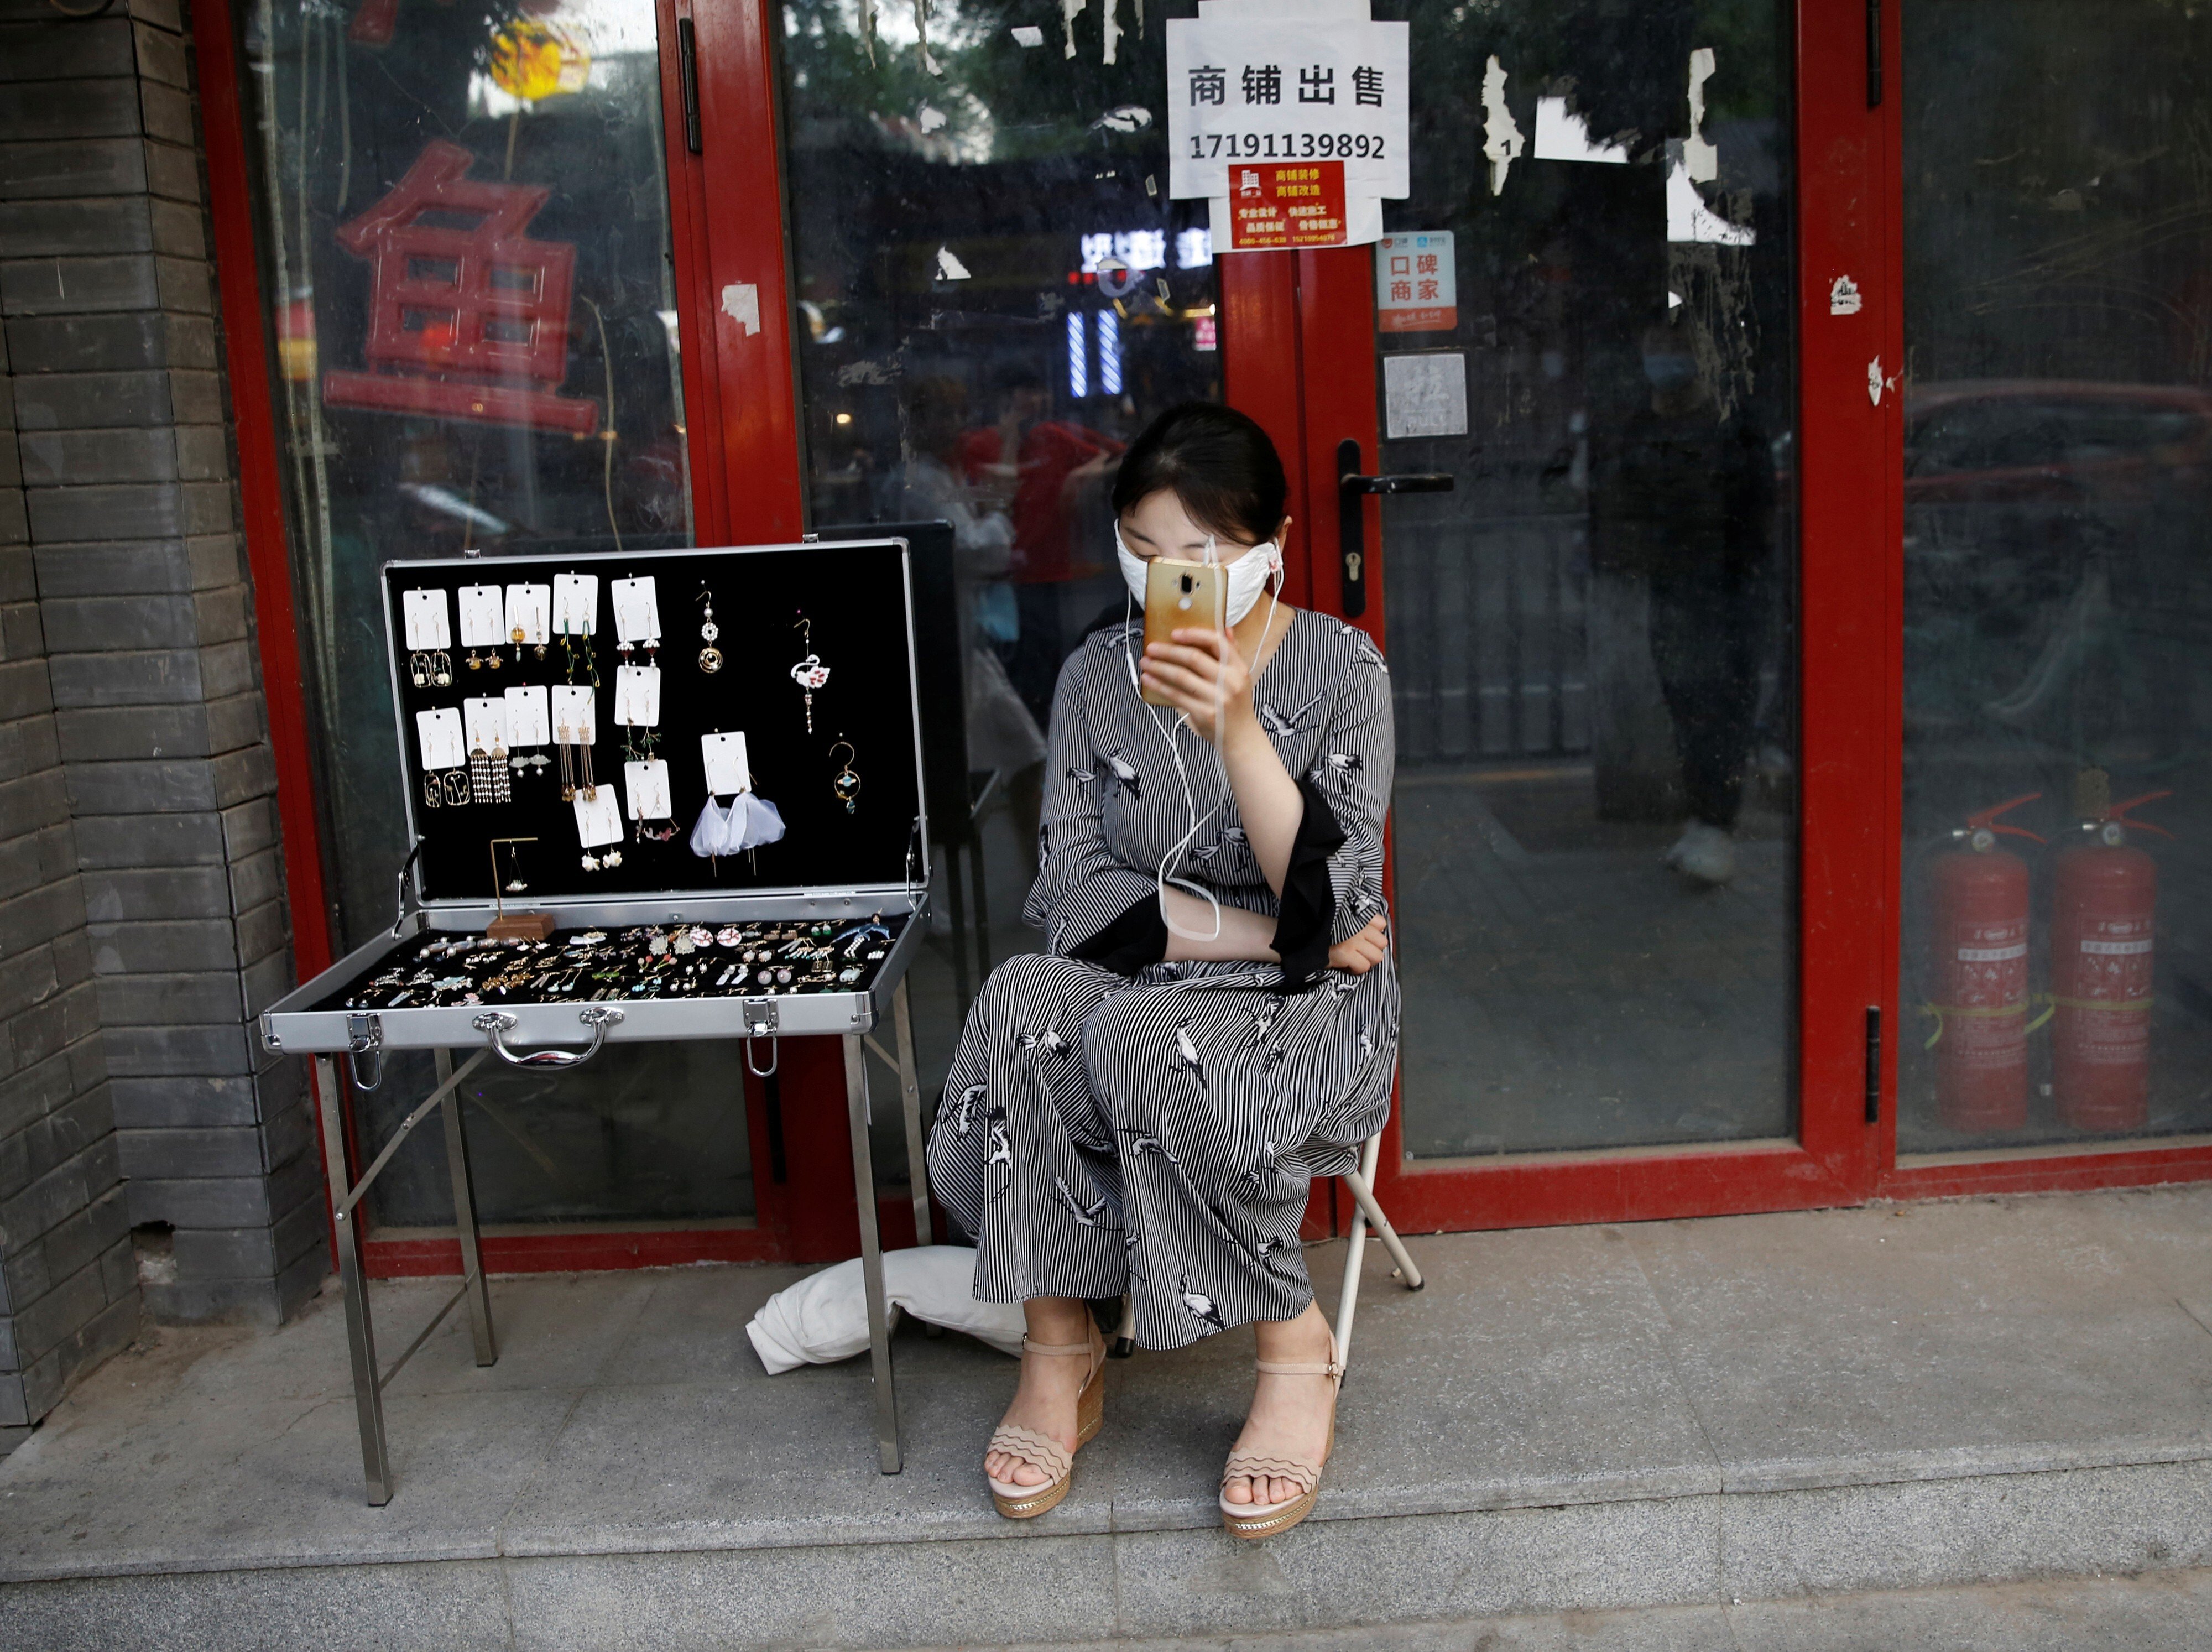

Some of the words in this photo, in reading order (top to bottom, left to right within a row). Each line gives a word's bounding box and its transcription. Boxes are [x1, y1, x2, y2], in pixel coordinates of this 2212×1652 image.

[1188, 65, 1384, 107] 商铺出售
[1191, 133, 1385, 159] 17191139892
[1275, 168, 1320, 182] 商铺装修
[1276, 184, 1321, 198] 商铺改造
[1390, 254, 1438, 276] 口碑
[1390, 279, 1439, 301] 商家
